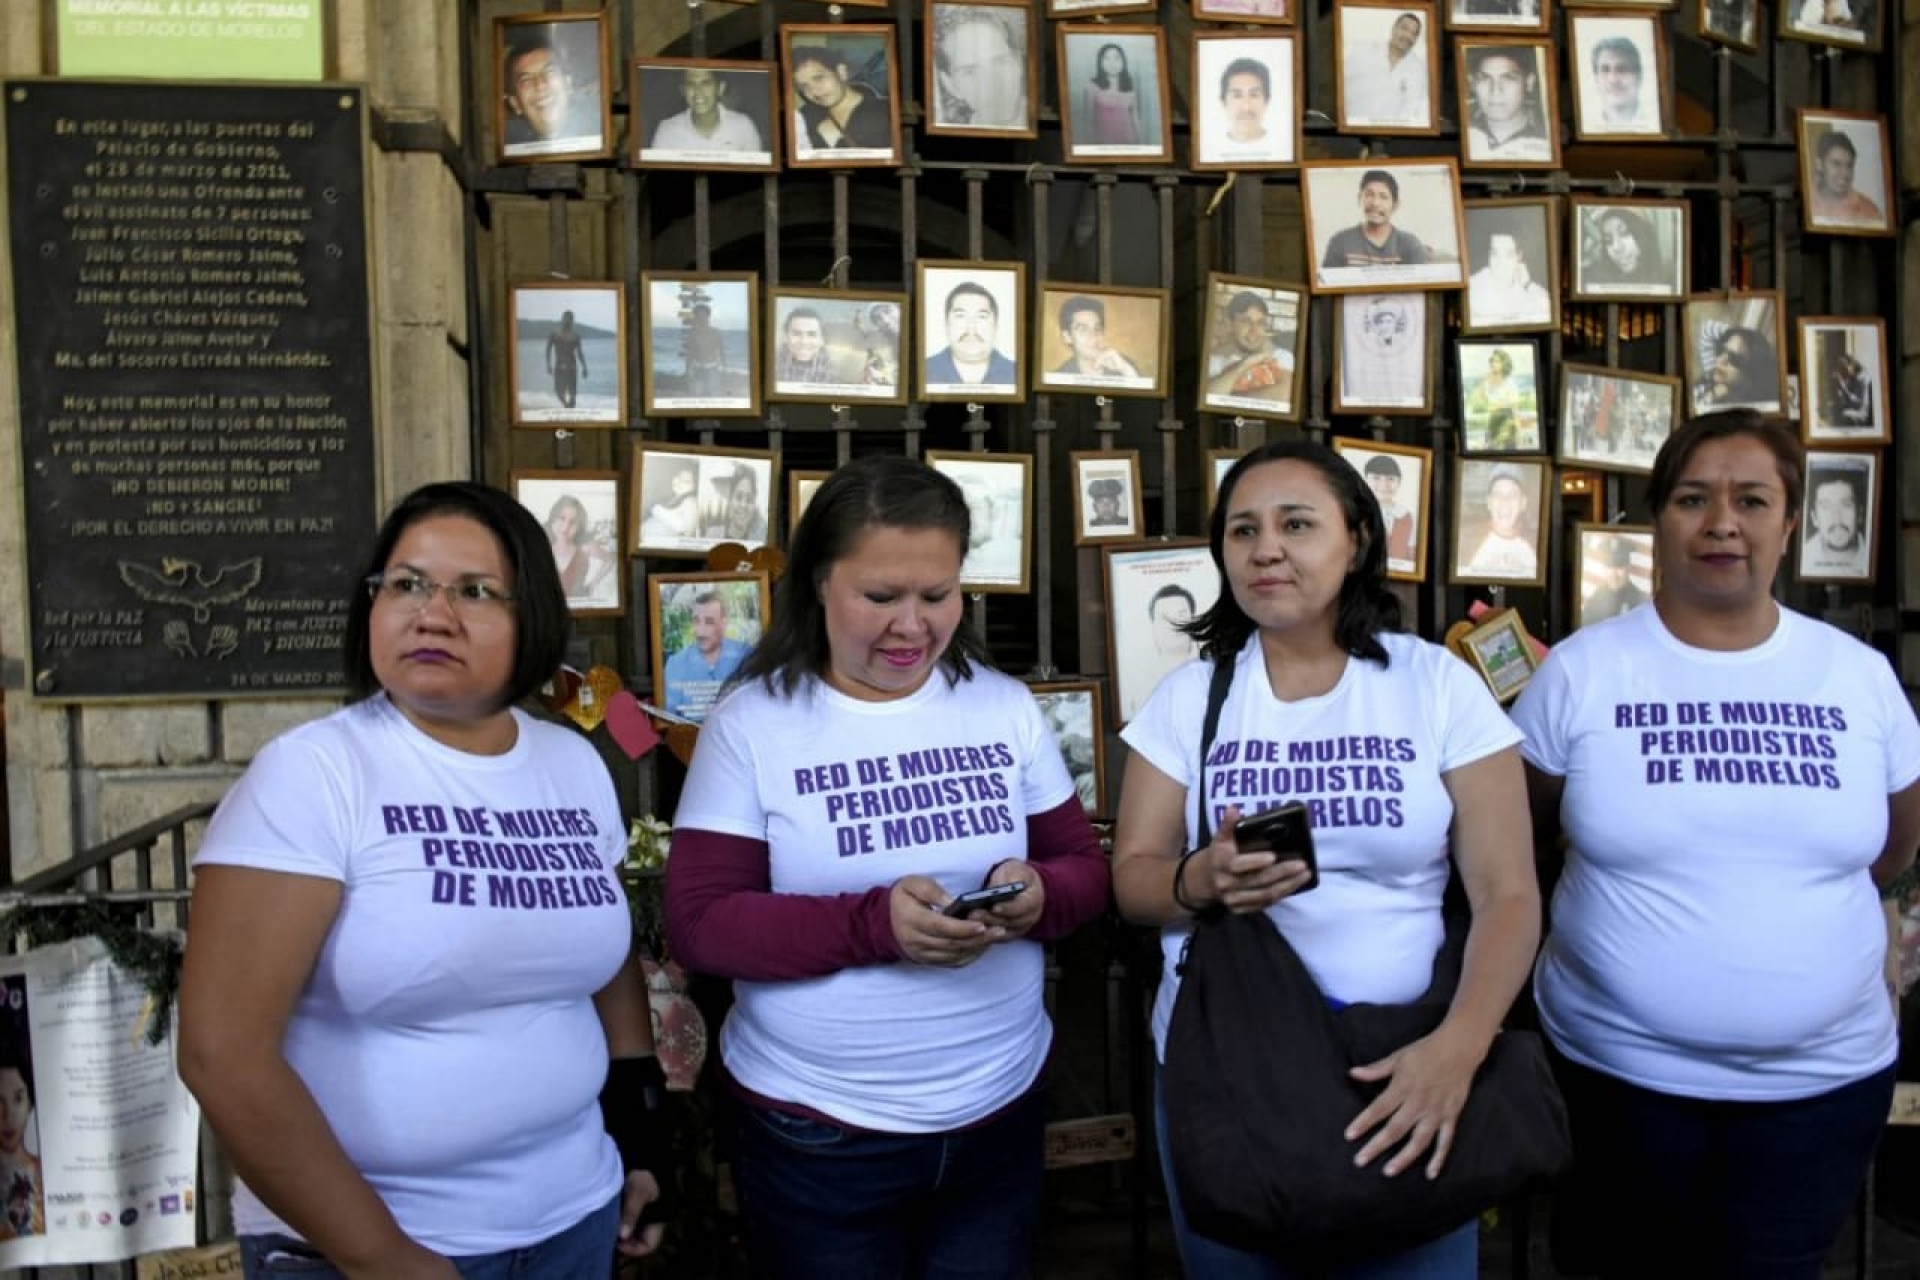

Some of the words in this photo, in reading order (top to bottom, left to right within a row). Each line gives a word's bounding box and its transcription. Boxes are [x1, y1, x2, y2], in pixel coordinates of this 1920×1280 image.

[1614, 702, 1669, 729] RED
[1676, 701, 1713, 725] DE
[1720, 701, 1847, 732] MUJERES
[1244, 739, 1279, 763] DE
[1288, 735, 1416, 762] MUJERES
[1640, 728, 1837, 760] PERIODISTAS
[793, 761, 850, 796] RED
[855, 756, 894, 786] DE
[897, 741, 1015, 780] MUJERES
[1210, 764, 1404, 799] PERIODISTAS
[1646, 758, 1684, 785] DE
[1694, 757, 1841, 790] MORELOS
[825, 772, 1009, 823] PERIODISTAS
[381, 803, 448, 835] RED
[453, 805, 494, 838] DE
[491, 807, 599, 839] MUJERES
[836, 823, 876, 858] DE
[882, 803, 1015, 850] MORELOS
[422, 837, 604, 873] PERIODISTAS
[431, 869, 476, 907] DE
[487, 873, 618, 910] MORELOS
